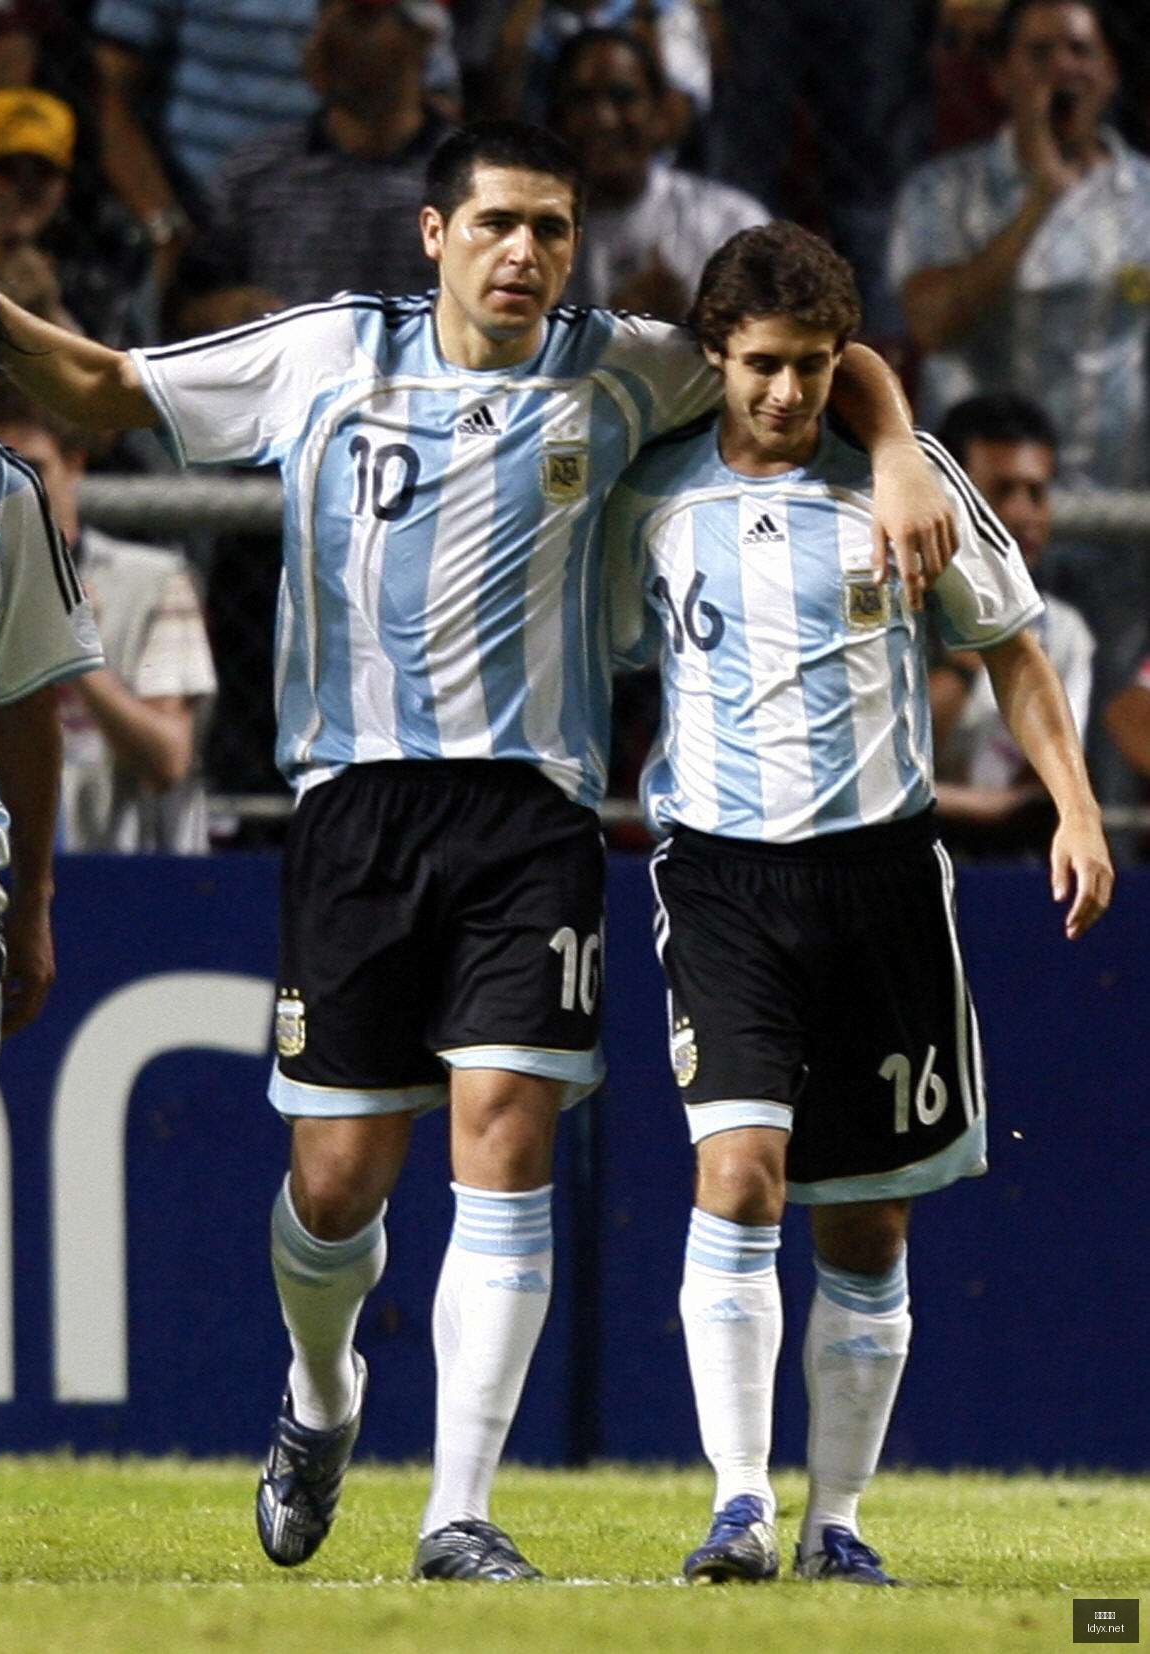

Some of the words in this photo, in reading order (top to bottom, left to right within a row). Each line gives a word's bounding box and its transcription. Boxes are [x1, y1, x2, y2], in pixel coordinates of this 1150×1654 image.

[349, 435, 421, 522] 10
[651, 569, 725, 654] 16
[549, 926, 599, 1016] 10
[877, 1044, 948, 1134] 16
